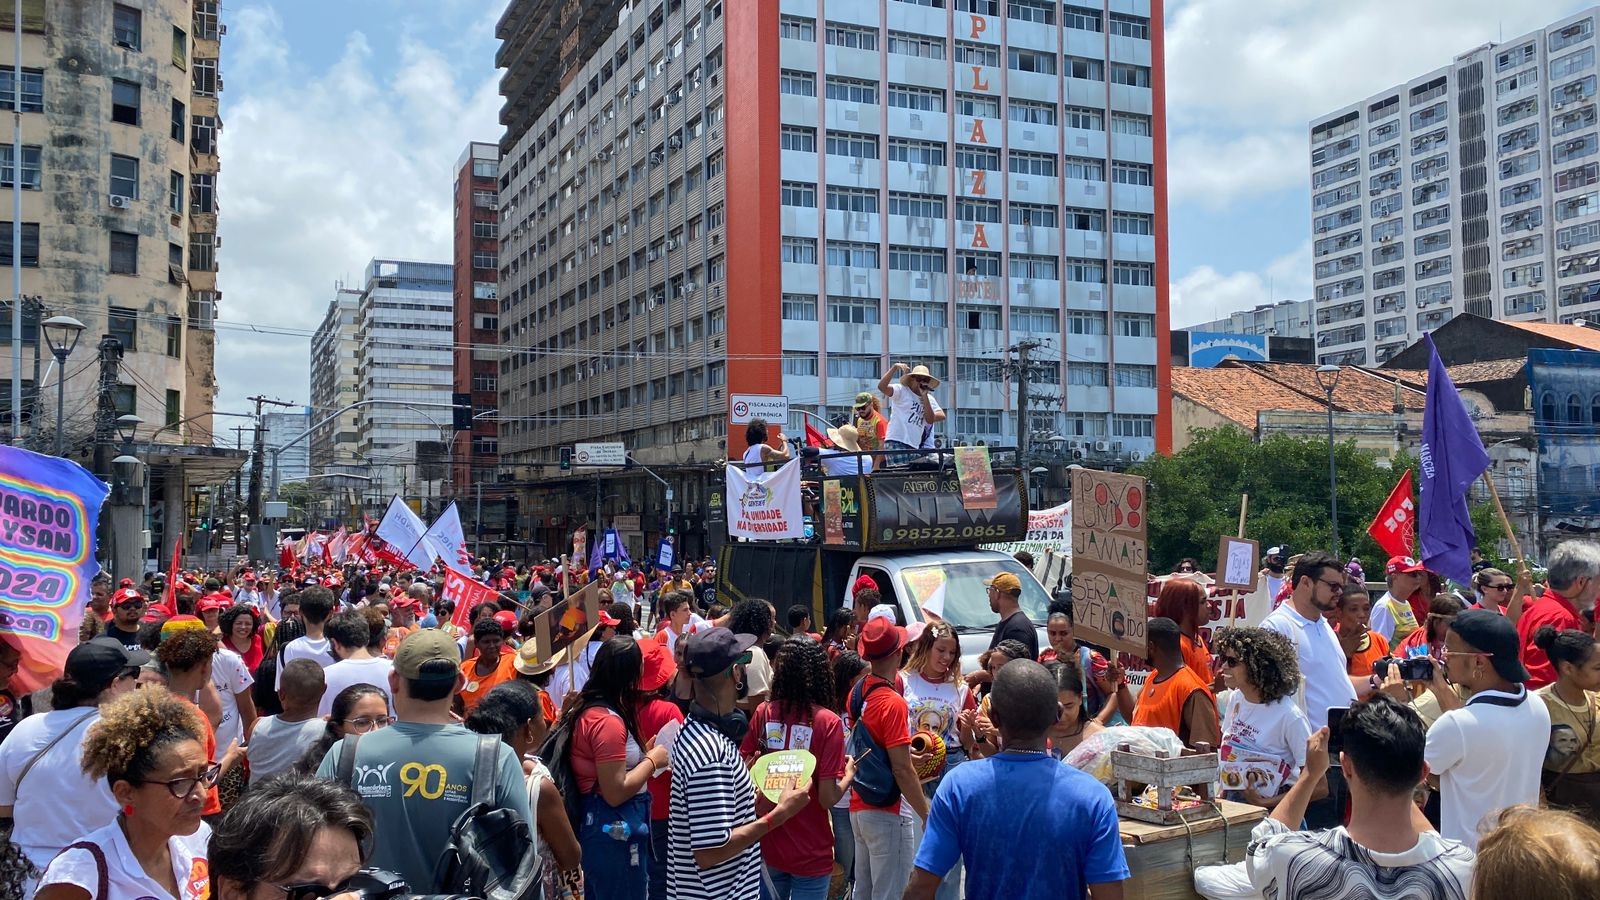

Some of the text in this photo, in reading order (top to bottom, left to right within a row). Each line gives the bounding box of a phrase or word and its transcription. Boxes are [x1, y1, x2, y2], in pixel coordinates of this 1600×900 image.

[969, 15, 989, 248] PLAZA
[903, 481, 937, 493] ALTO
[0, 491, 70, 528] ARDO
[751, 509, 782, 520] UNIDADE
[896, 525, 1006, 540] 98522.0865
[1027, 531, 1064, 540] ESA DA
[1076, 531, 1144, 568] JAMAIS
[400, 762, 447, 799] 90
[445, 783, 467, 792] ANOS
